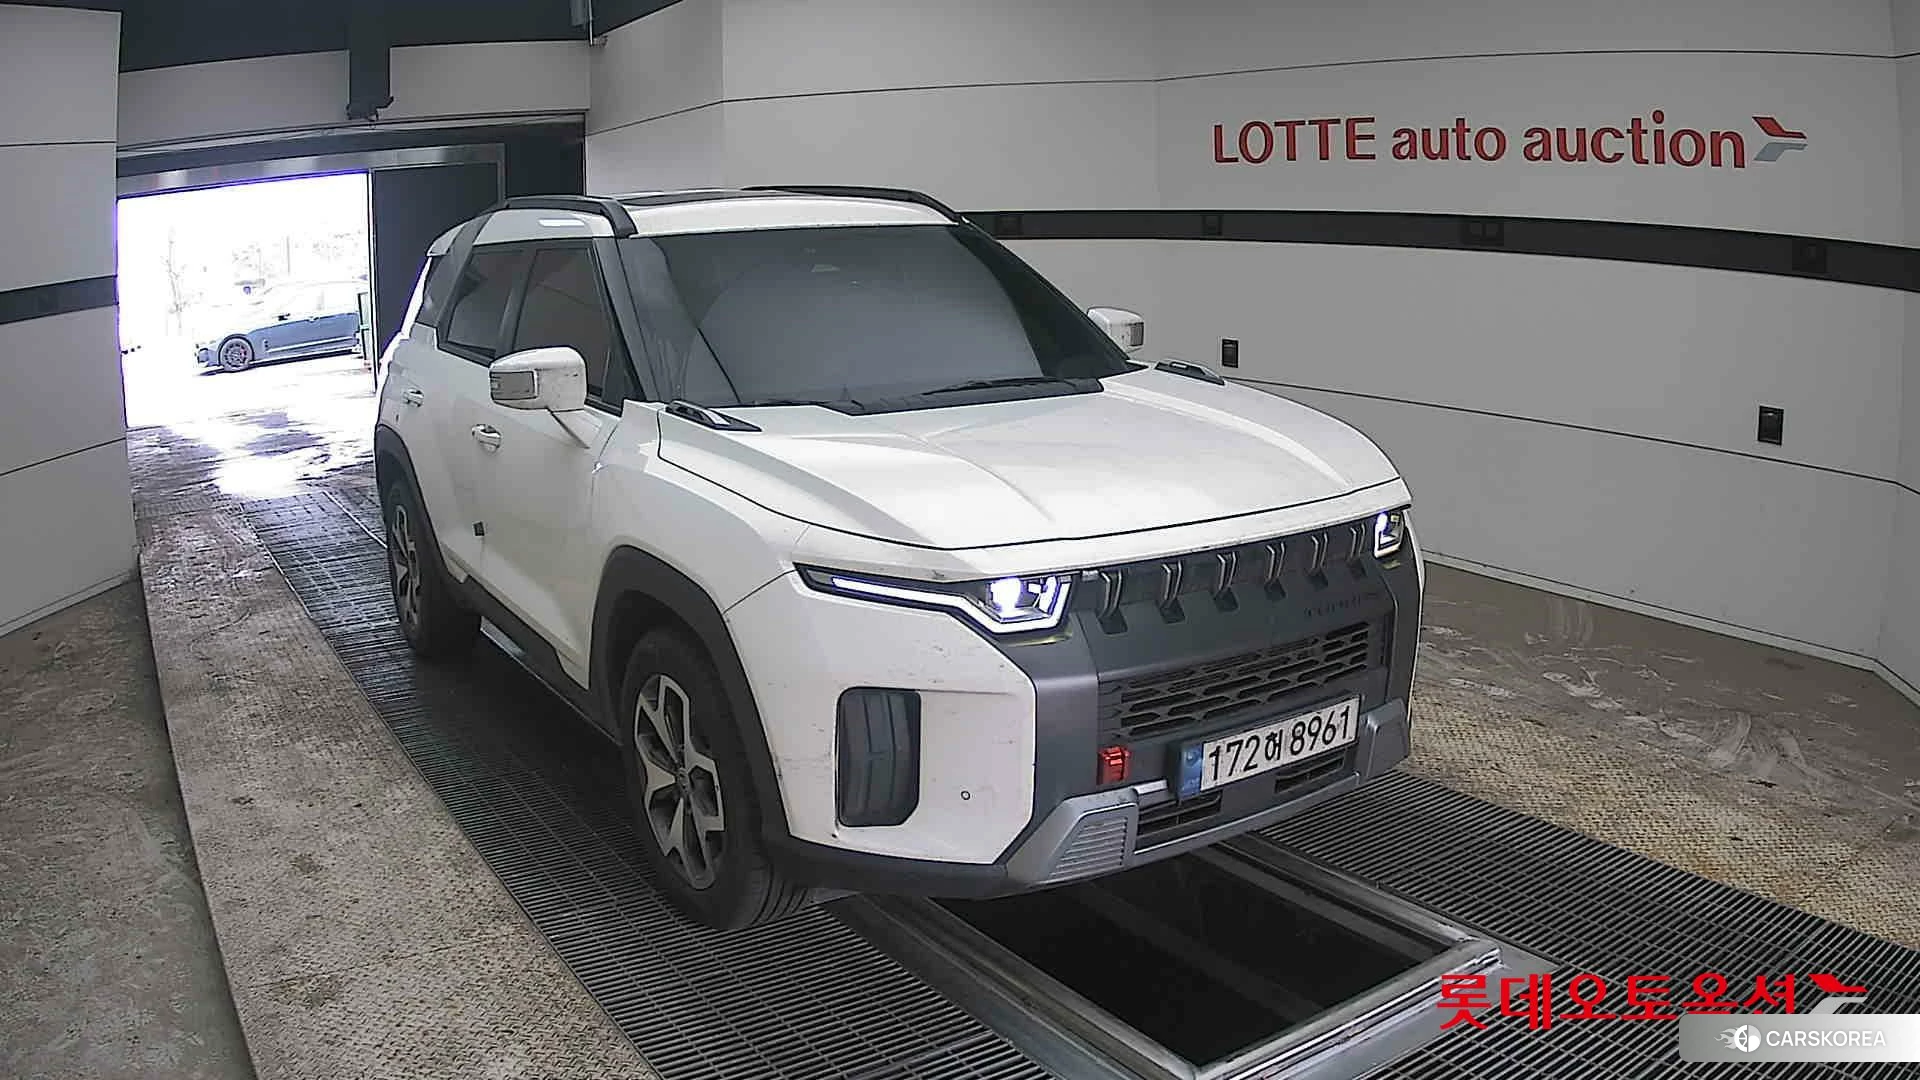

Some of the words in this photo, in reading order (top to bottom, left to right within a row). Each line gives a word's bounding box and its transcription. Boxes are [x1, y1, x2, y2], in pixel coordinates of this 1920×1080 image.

[1213, 117, 1377, 164] LOTTE
[1391, 117, 1507, 162] auto
[1522, 109, 1746, 169] auction
